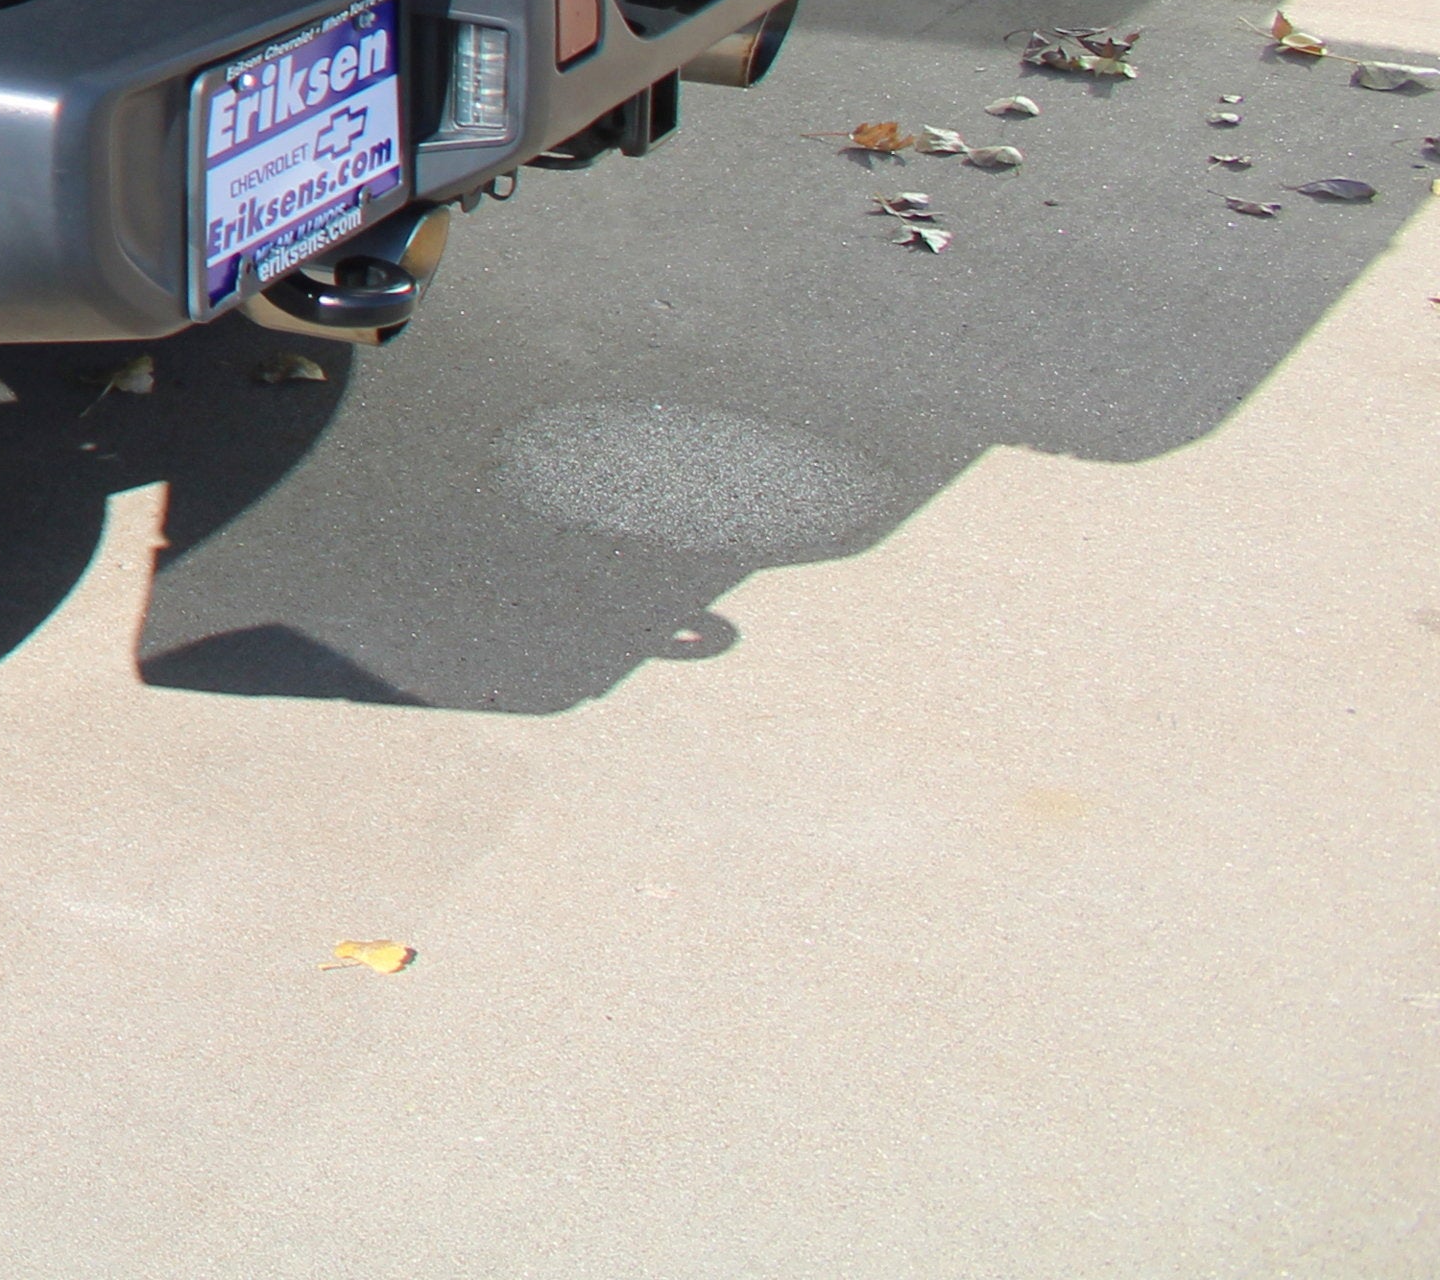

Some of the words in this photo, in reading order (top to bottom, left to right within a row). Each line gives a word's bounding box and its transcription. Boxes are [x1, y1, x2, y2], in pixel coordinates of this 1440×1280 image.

[206, 27, 388, 159] Eriksen
[207, 137, 392, 257] Eriksens.com
[230, 142, 311, 198] CHEVROLET
[258, 206, 363, 283] eriksens.com
